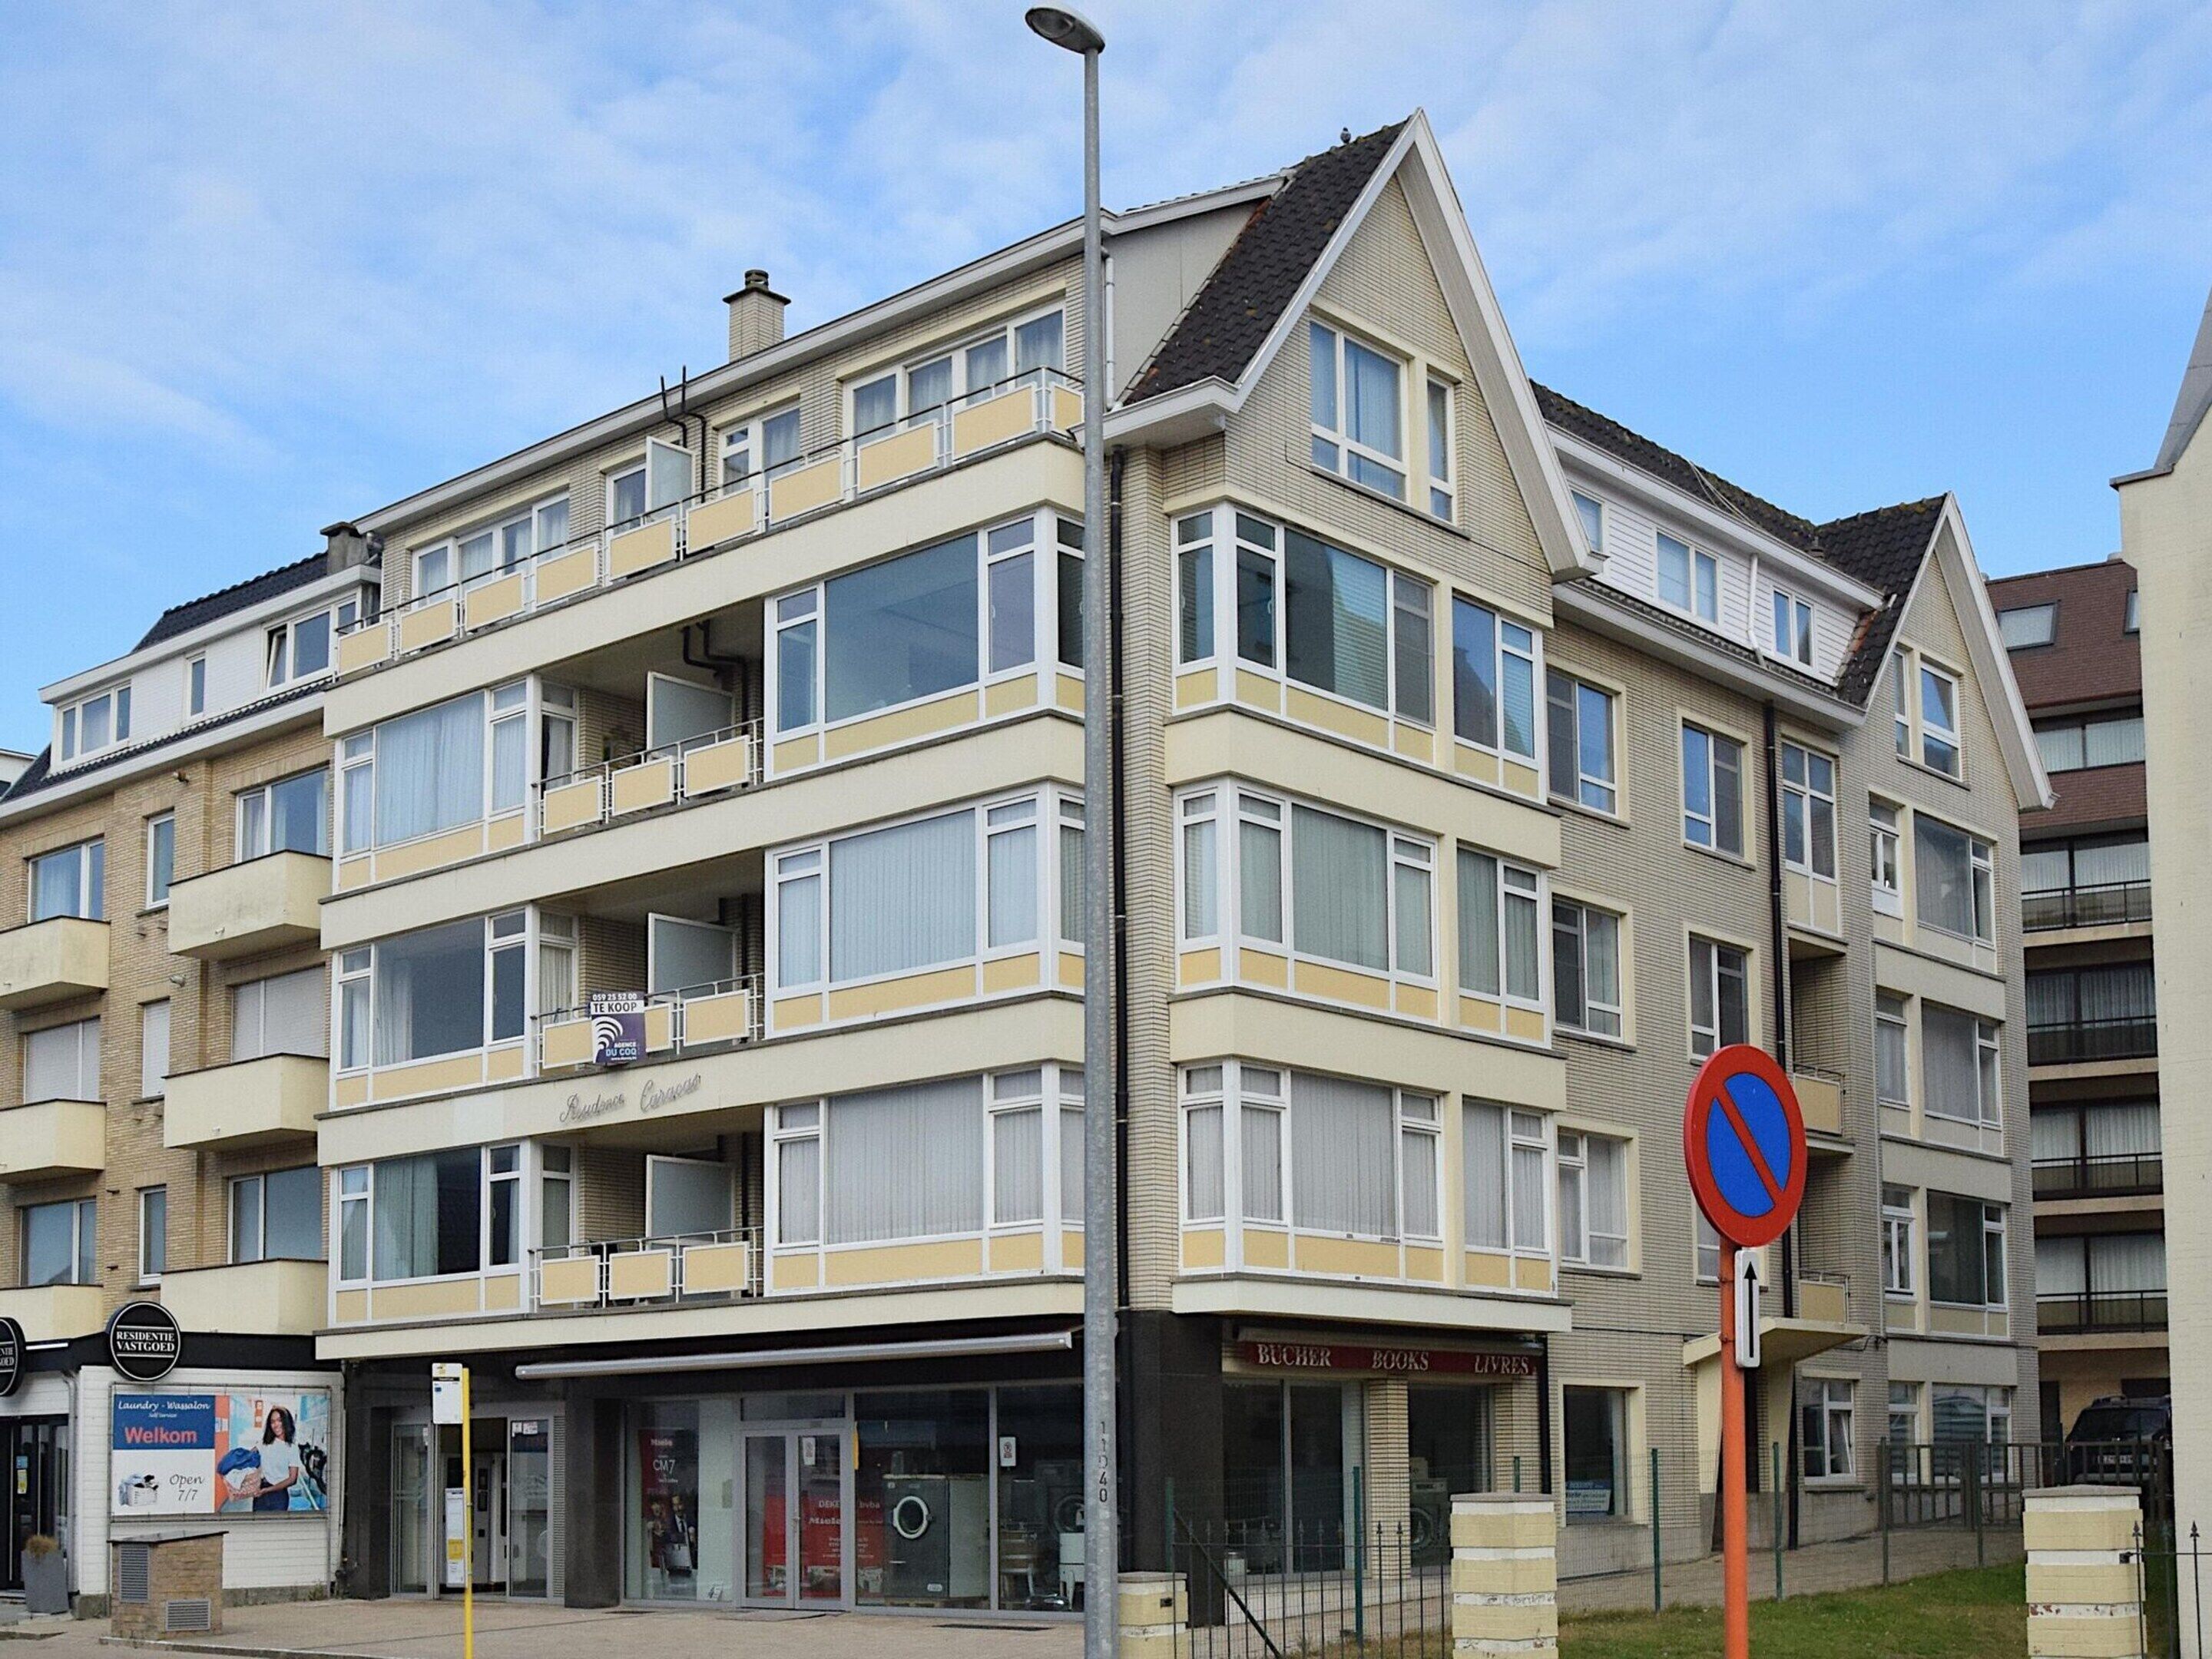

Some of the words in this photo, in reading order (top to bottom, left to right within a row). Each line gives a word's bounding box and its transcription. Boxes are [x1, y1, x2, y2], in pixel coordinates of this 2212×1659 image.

[594, 1003, 604, 1012] TE
[608, 1002, 637, 1012] KOOP
[605, 1048, 618, 1057] DU
[619, 1048, 637, 1056] COQ
[116, 1331, 175, 1341] RESIDENTIE
[116, 1341, 175, 1352] VASTGOED
[1372, 1349, 1429, 1371] BOOKS
[1475, 1354, 1529, 1375] LIVRES
[118, 1400, 159, 1412] Laundry
[167, 1401, 211, 1410] Wassalon
[124, 1426, 198, 1444] Welkom
[170, 1474, 205, 1488] Open
[178, 1488, 198, 1502] 7/7
